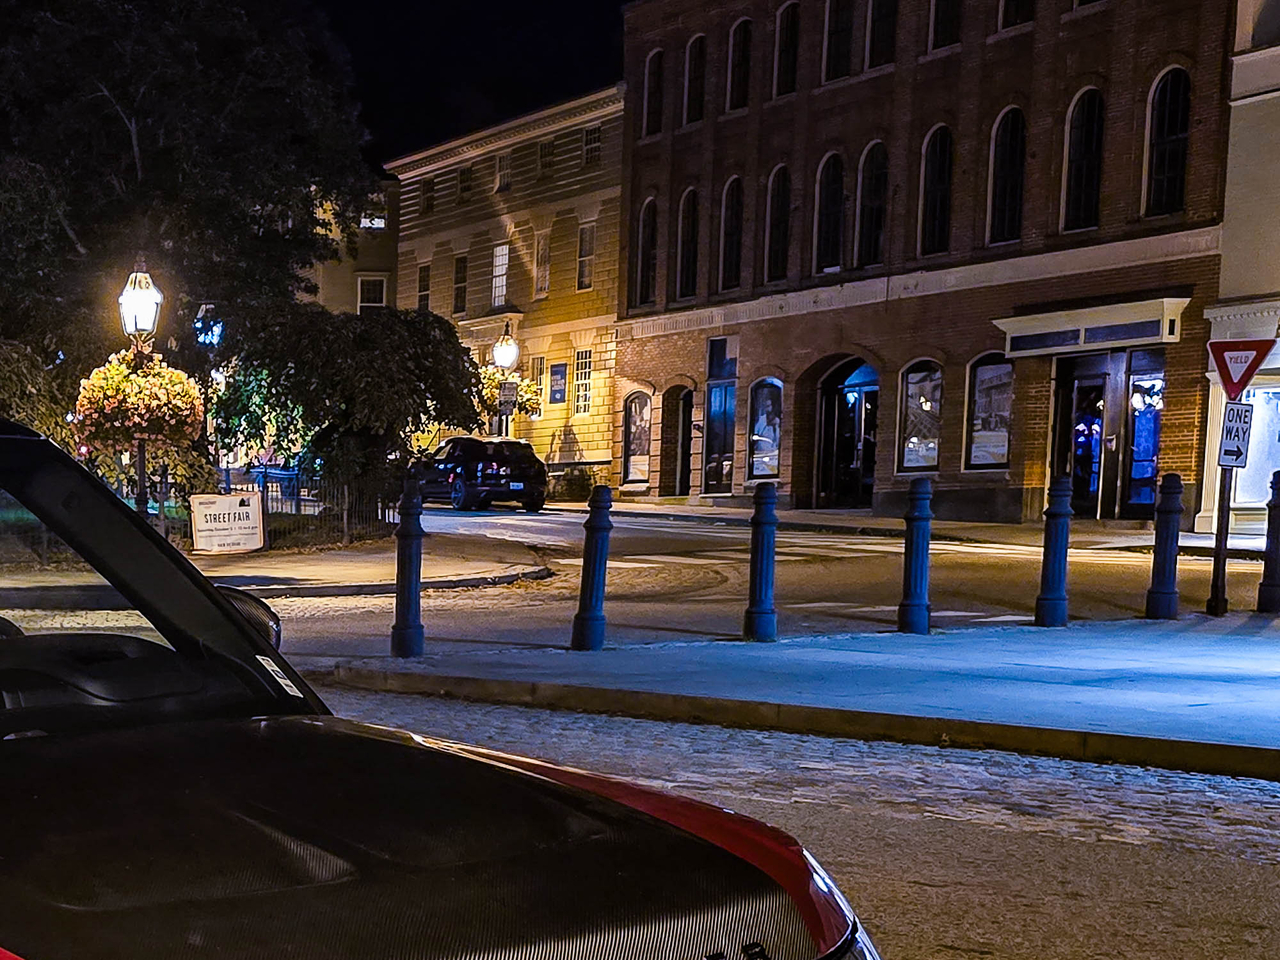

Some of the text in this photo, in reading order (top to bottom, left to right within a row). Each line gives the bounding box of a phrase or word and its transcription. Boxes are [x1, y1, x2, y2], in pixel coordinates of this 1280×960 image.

[1229, 356, 1250, 364] YIELD
[1227, 408, 1250, 424] ONE
[1225, 426, 1249, 442] WAY
[204, 511, 250, 524] STREET FAIR
